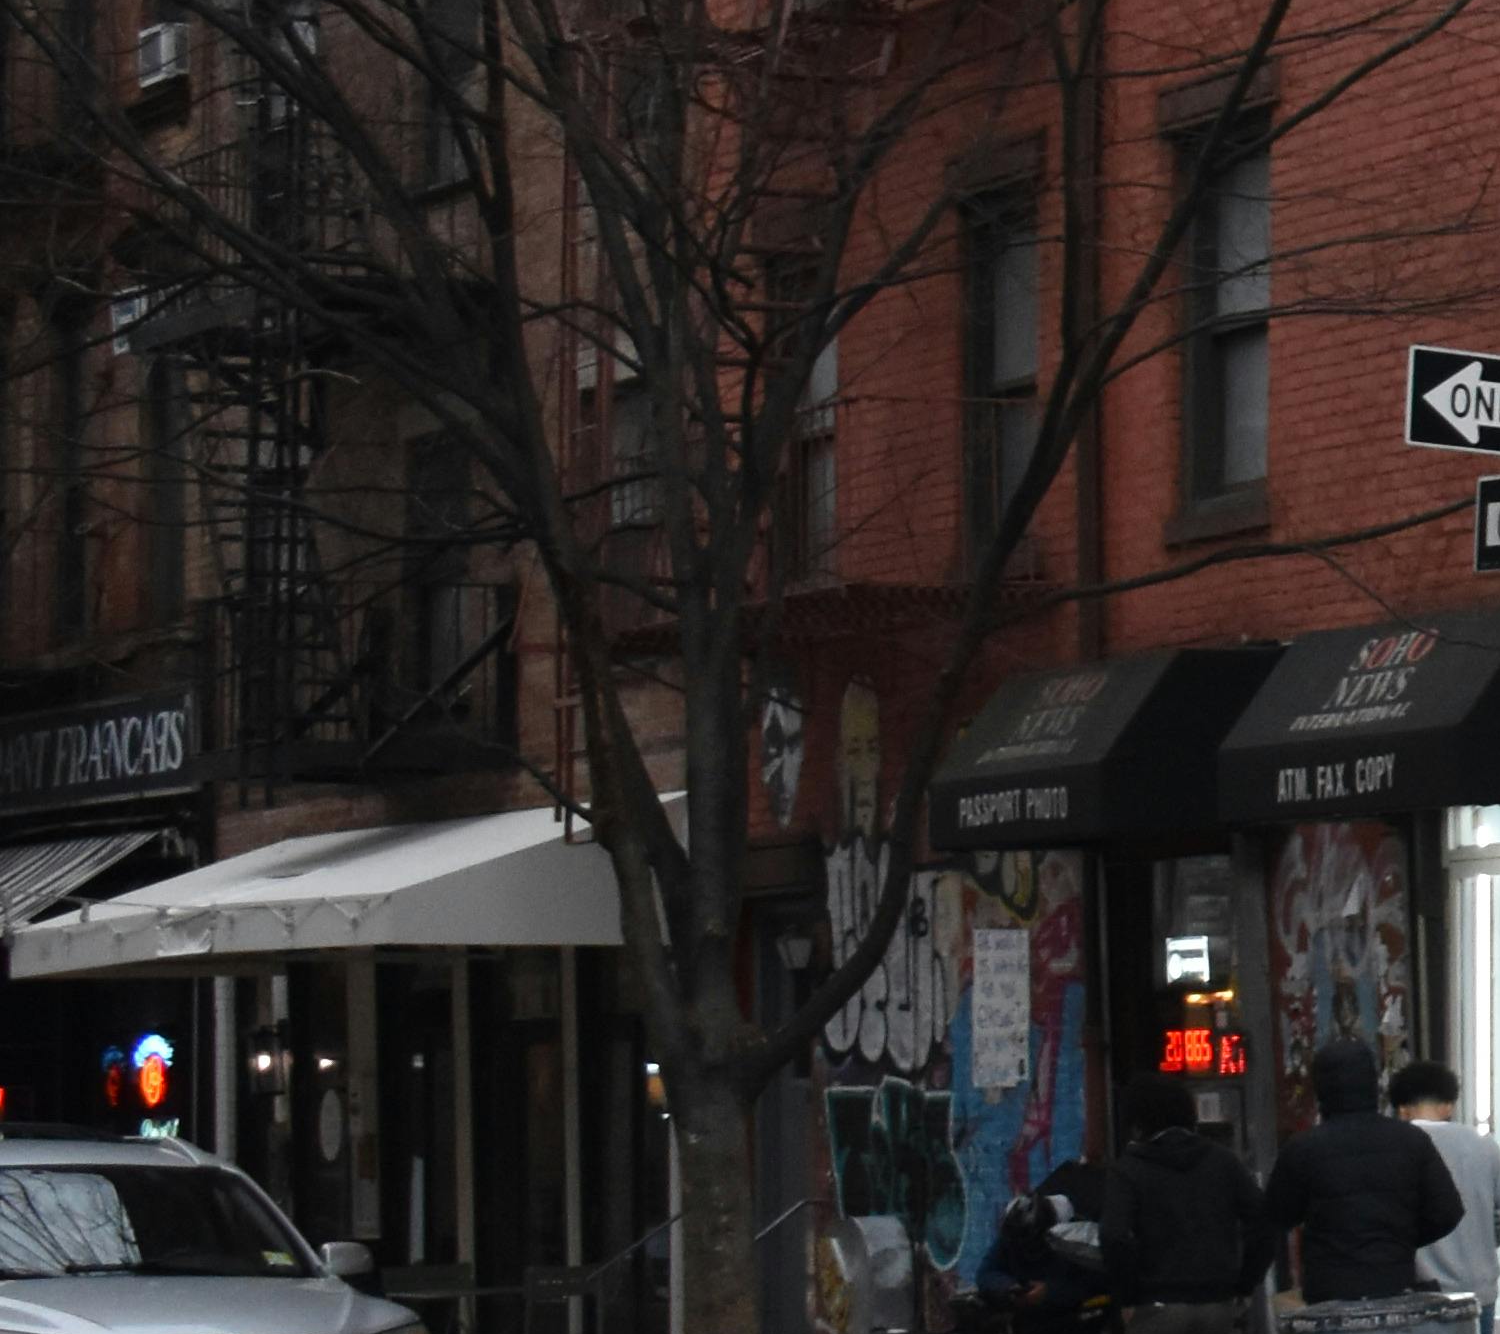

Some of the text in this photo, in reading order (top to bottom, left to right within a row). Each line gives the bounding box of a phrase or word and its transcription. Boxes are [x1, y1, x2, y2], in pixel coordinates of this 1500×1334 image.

[1348, 629, 1439, 671] SOHO
[1323, 667, 1416, 710] NEWS
[1354, 754, 1395, 794] COPY
[958, 787, 1069, 828] PASSPORT PHOTO
